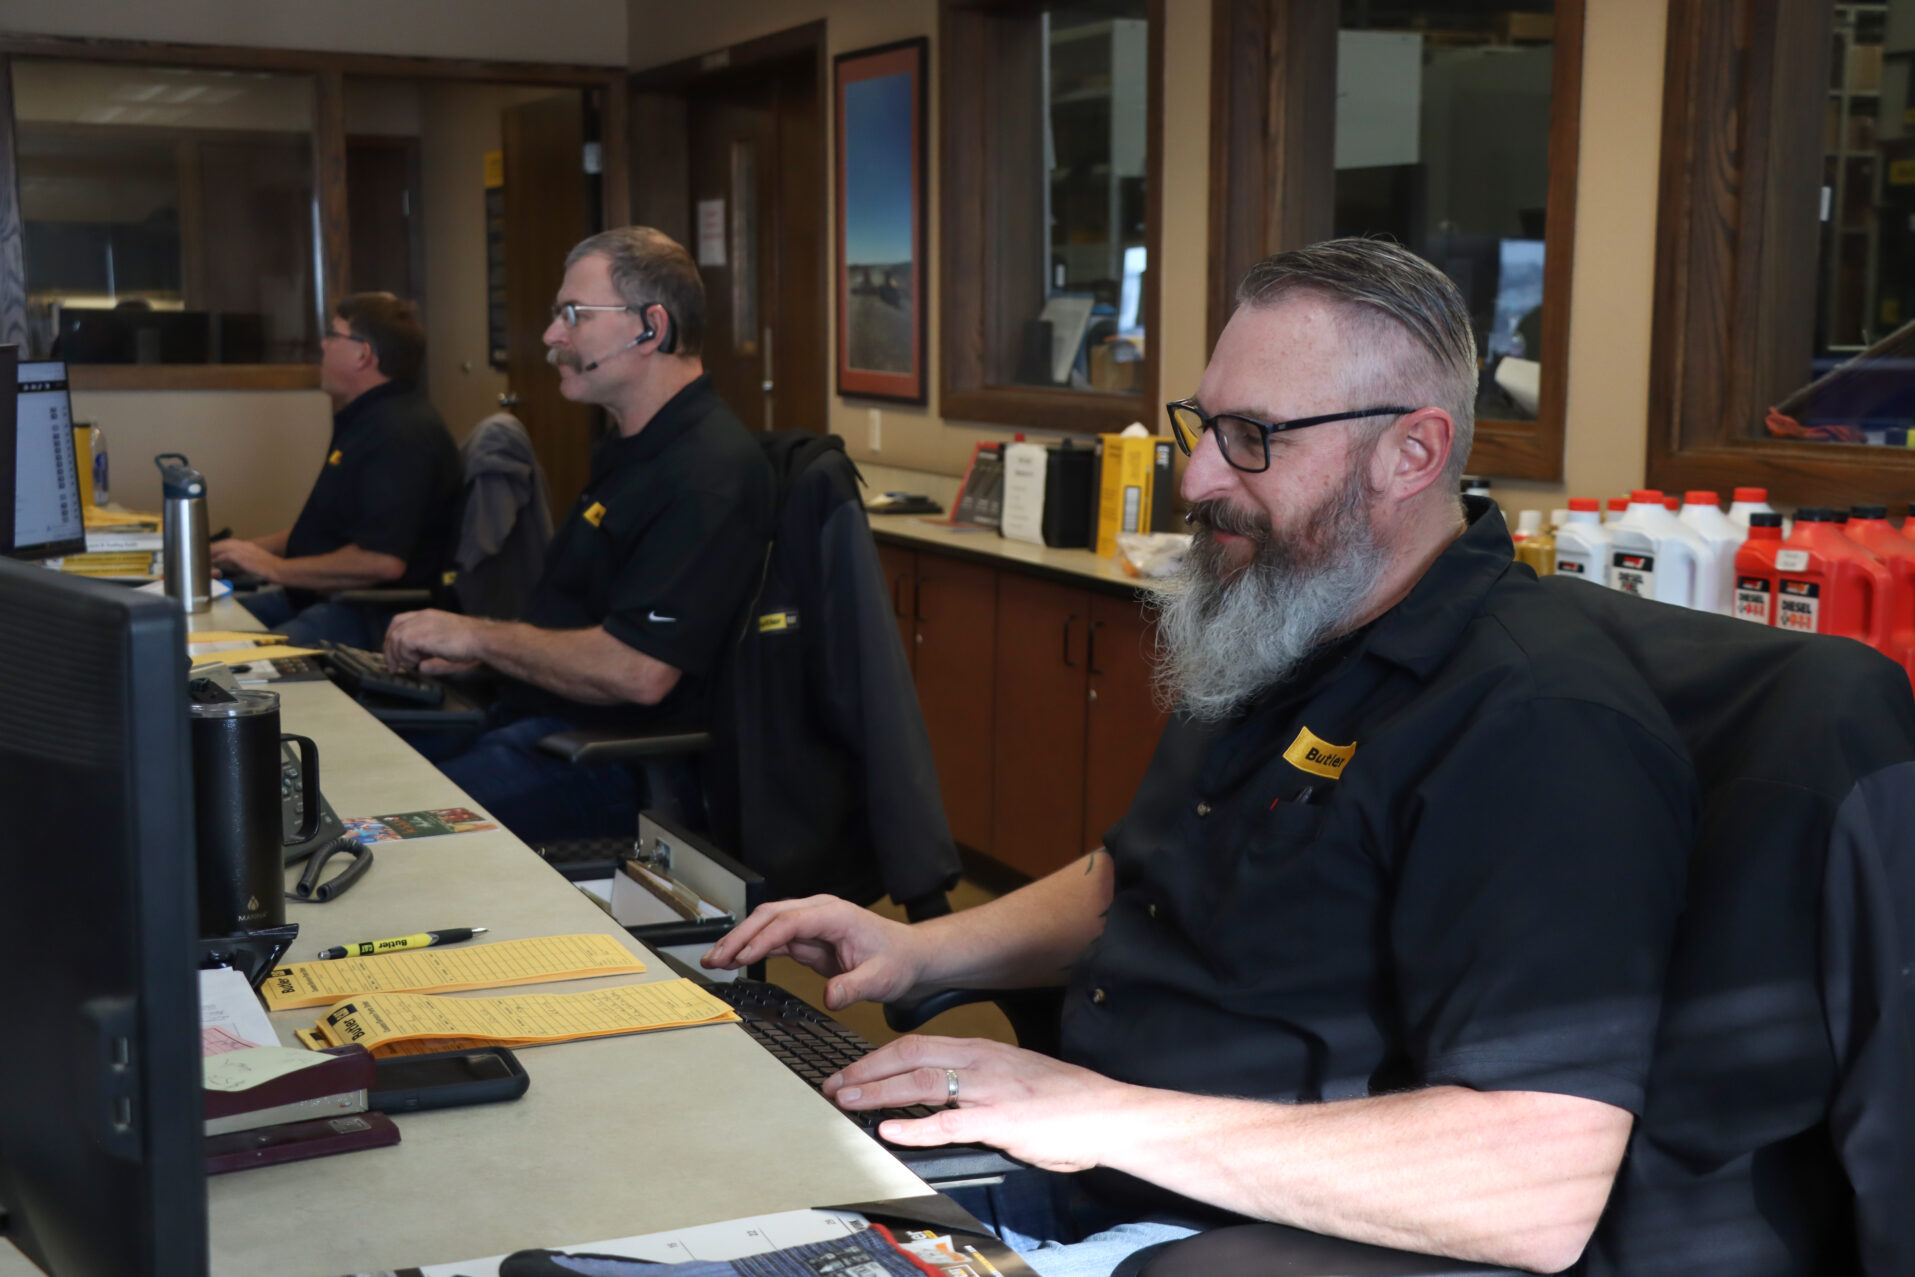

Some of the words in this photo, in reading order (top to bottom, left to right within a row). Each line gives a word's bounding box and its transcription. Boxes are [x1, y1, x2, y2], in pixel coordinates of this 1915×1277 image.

[1306, 747, 1345, 767] Butler
[378, 939, 407, 949] Butler
[277, 978, 295, 994] Butler
[344, 1017, 366, 1041] Butler
